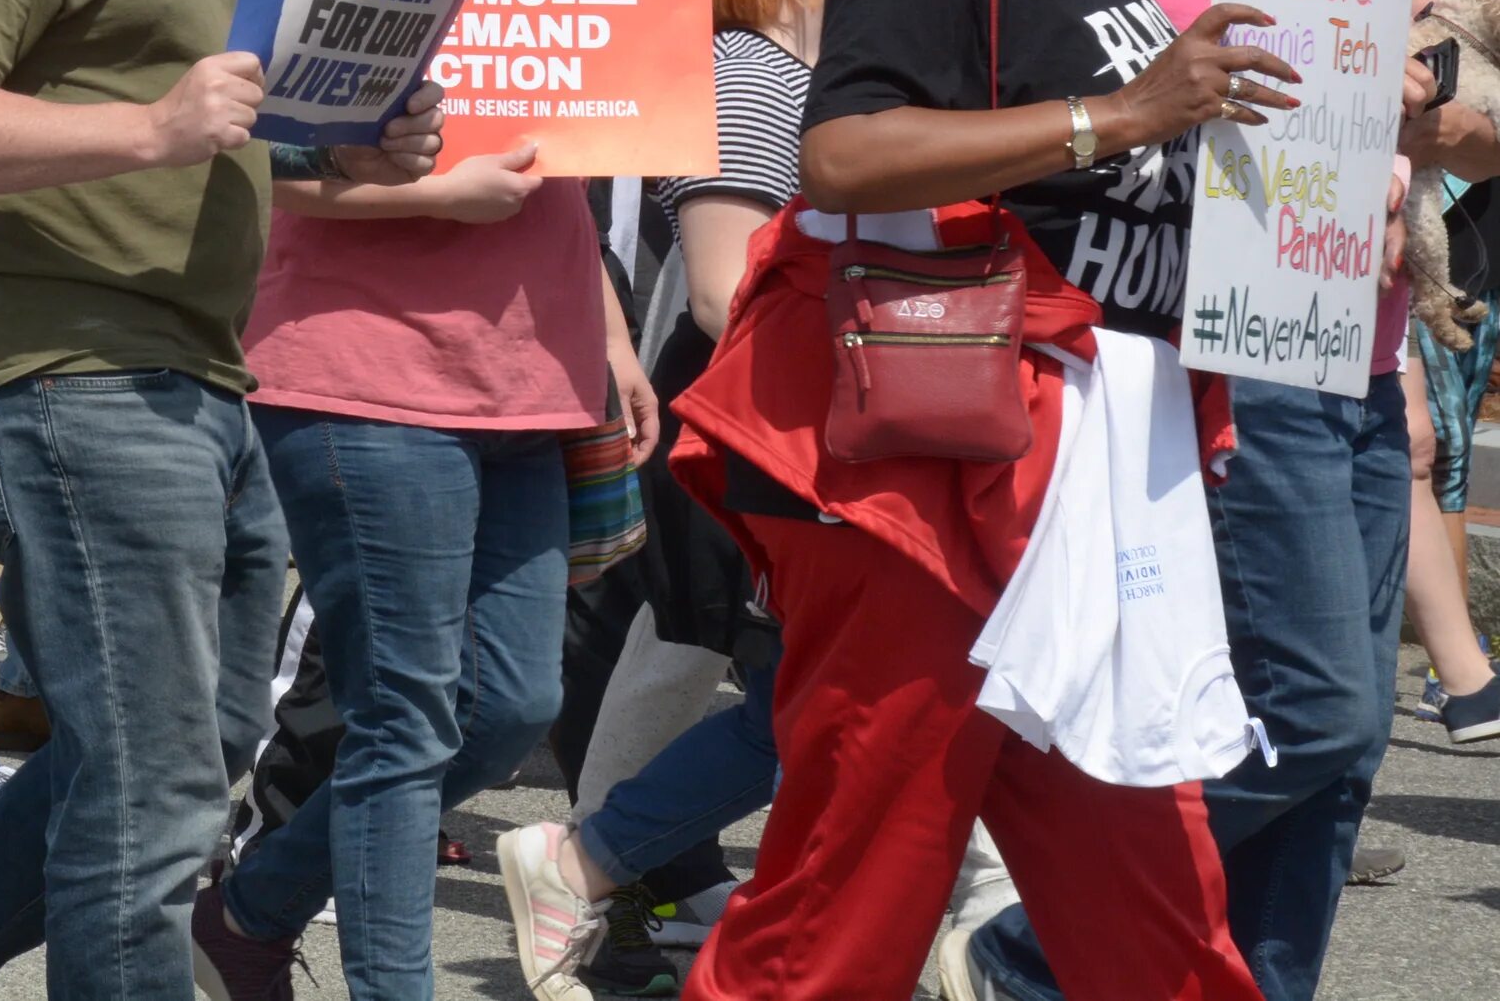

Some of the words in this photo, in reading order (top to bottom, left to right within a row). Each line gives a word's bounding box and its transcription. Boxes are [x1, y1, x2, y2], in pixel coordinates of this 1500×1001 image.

[363, 7, 438, 59] OUR
[1328, 16, 1378, 78] Tech
[267, 52, 375, 107] LIVES
[424, 53, 583, 92] CTION
[475, 99, 529, 118] SENSE
[533, 99, 551, 117] IN
[556, 99, 640, 118] AMERICA
[1350, 91, 1398, 155] Hook
[1204, 136, 1251, 200] Las
[1261, 144, 1340, 224] Vegas
[1276, 203, 1374, 281] Parkland
[1192, 285, 1363, 386] #NeverAgain
